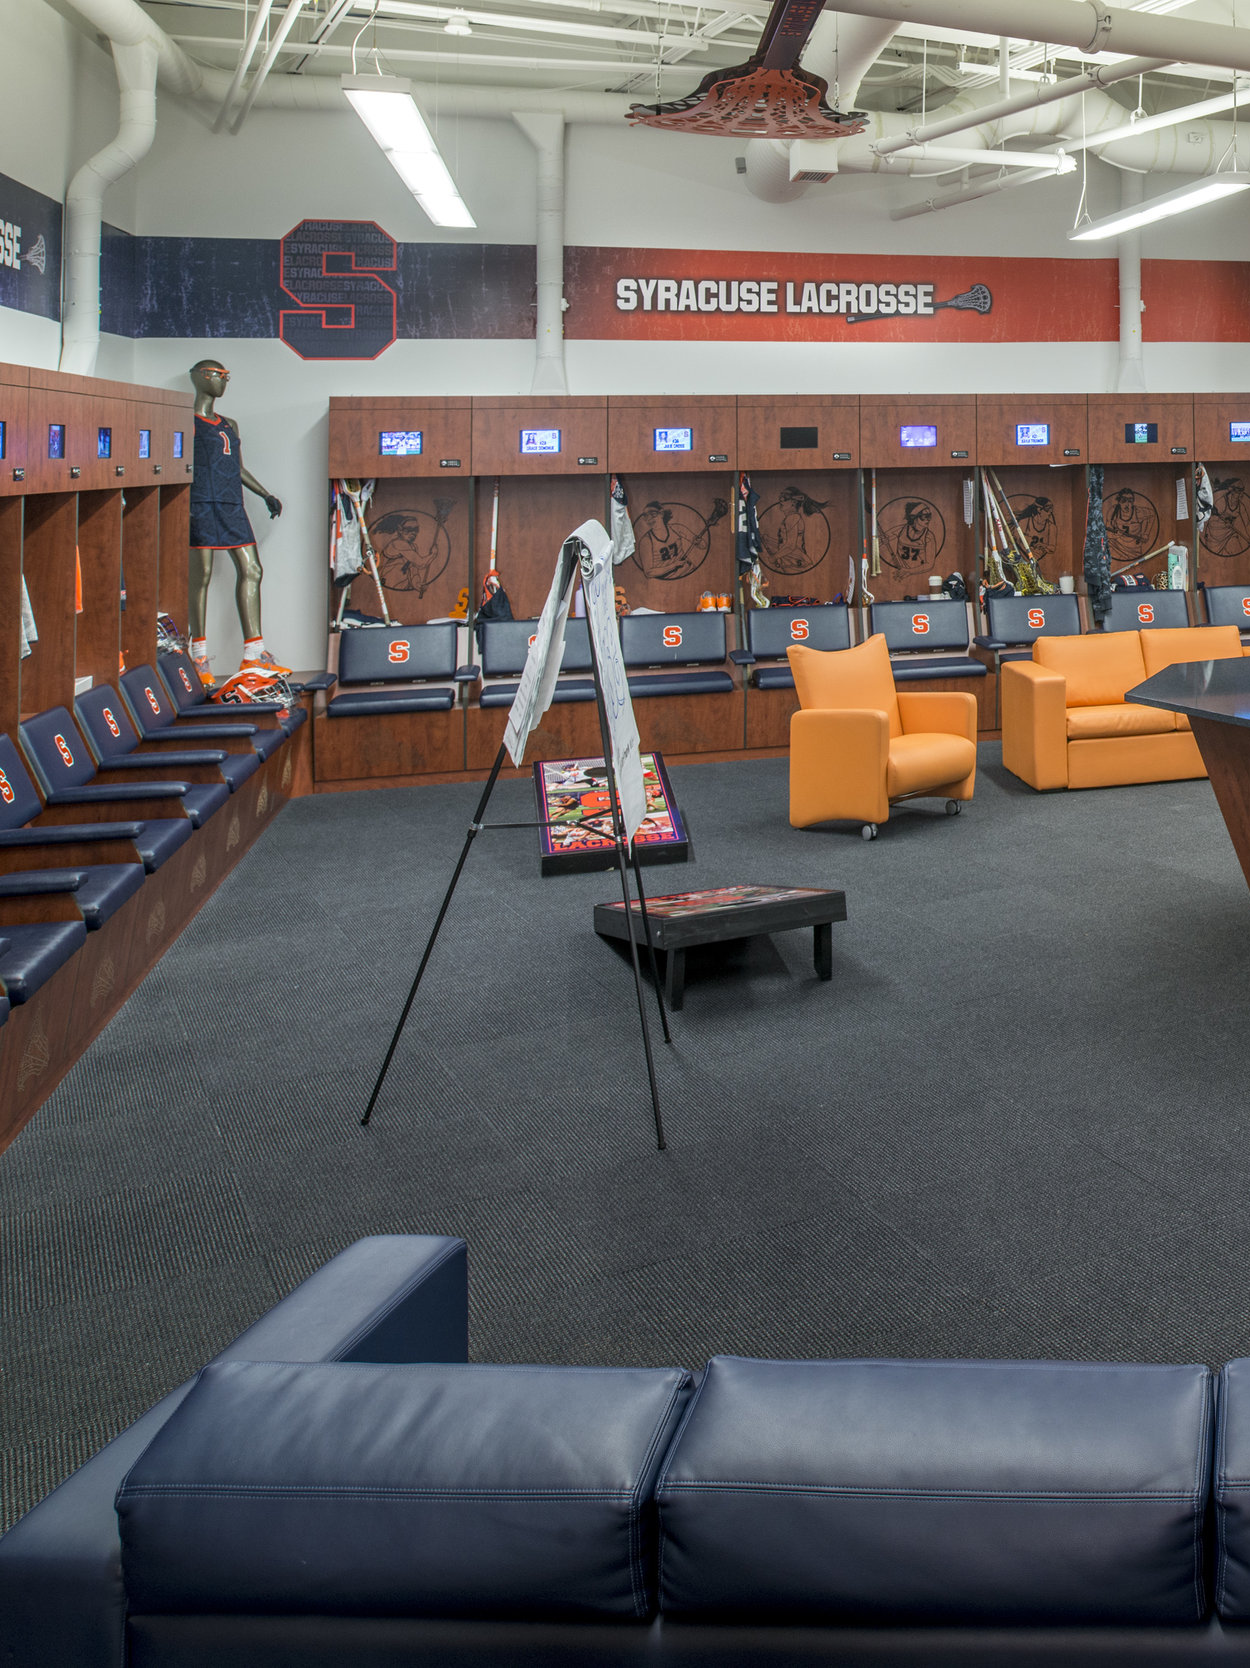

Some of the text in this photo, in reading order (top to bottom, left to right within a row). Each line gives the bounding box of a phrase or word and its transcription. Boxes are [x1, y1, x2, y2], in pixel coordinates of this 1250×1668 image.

[616, 278, 934, 314] SYRACUSE LACROSSE
[659, 543, 679, 561] 27
[901, 545, 920, 561] 37
[912, 613, 930, 634] S
[1027, 608, 1045, 628] S
[1138, 604, 1154, 623] S
[662, 625, 683, 648] S
[791, 619, 809, 640] S
[388, 640, 410, 664] S
